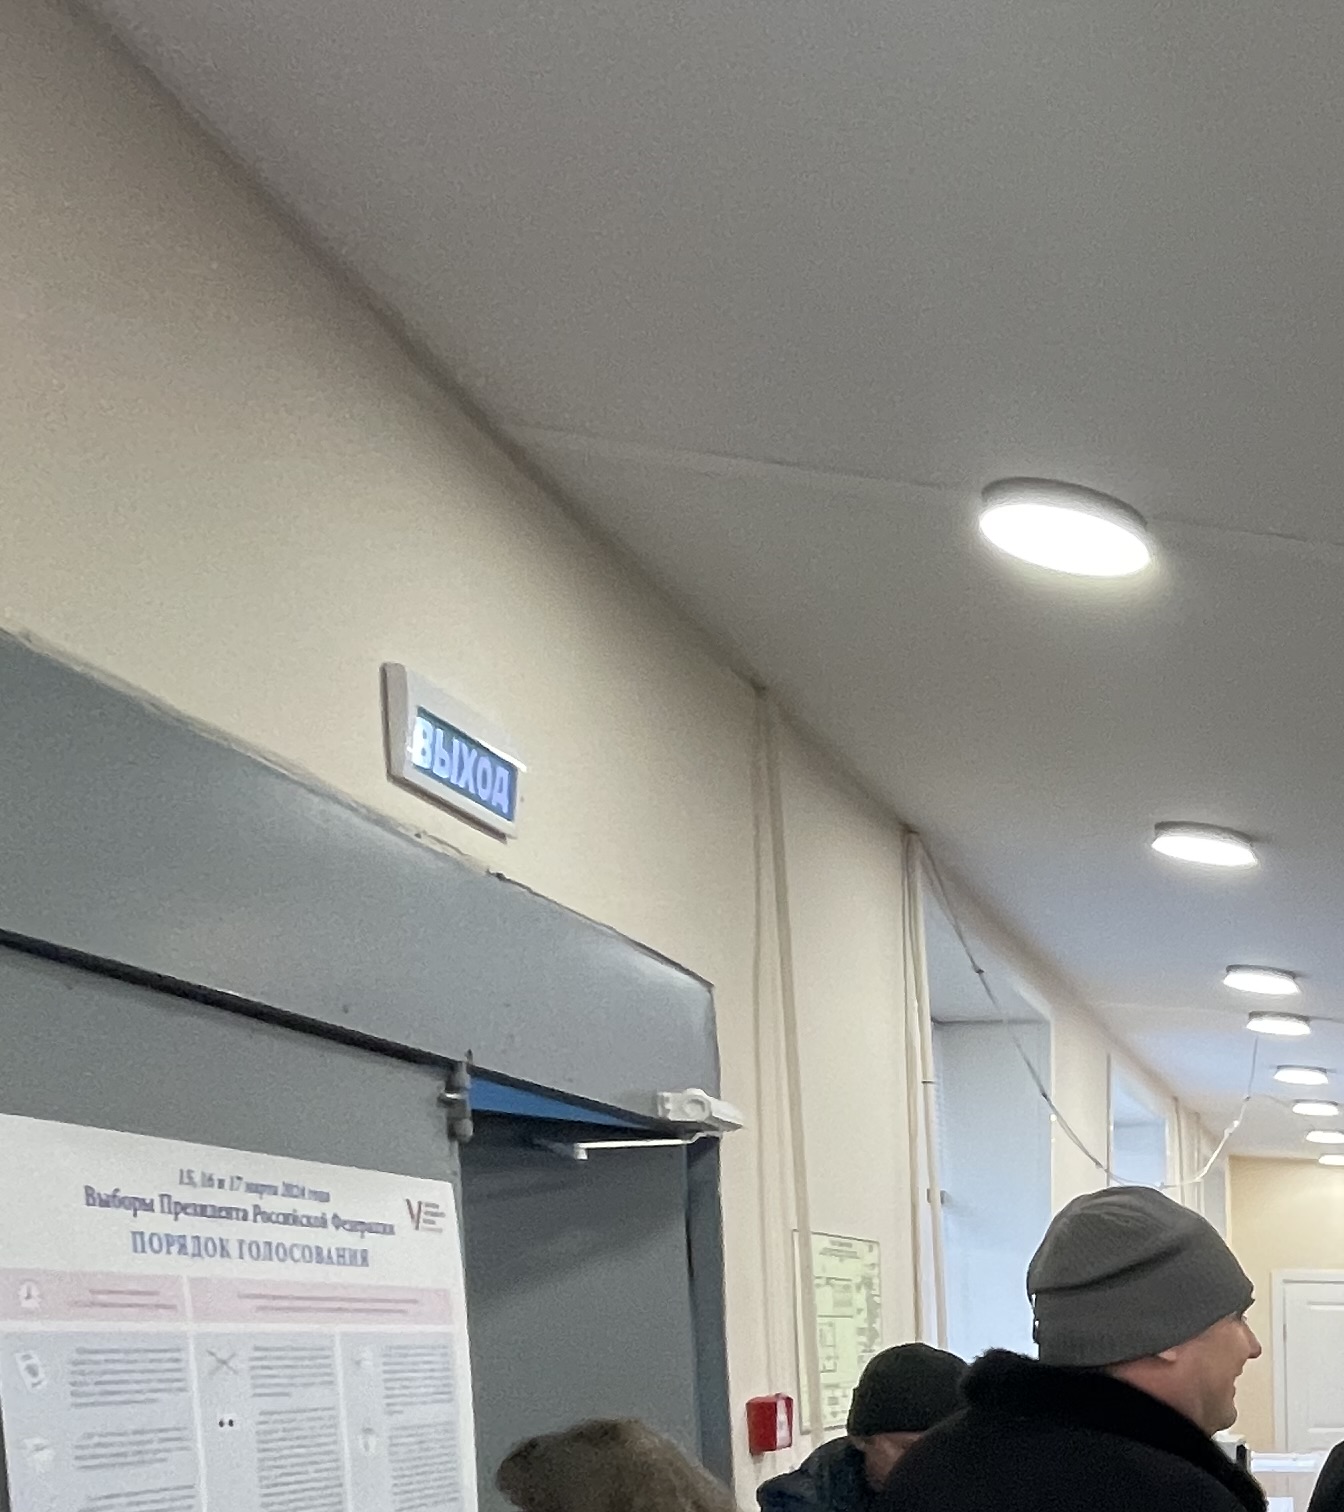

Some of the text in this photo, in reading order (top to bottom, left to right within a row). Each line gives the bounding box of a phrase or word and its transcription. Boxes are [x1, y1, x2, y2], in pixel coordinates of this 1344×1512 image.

[411, 716, 510, 814] ВЫХОД
[84, 1184, 155, 1218] Выборы
[252, 1204, 328, 1229] Российской
[131, 1230, 370, 1268] ПОРЯДОК ГОЛОСОВАНИЯ
